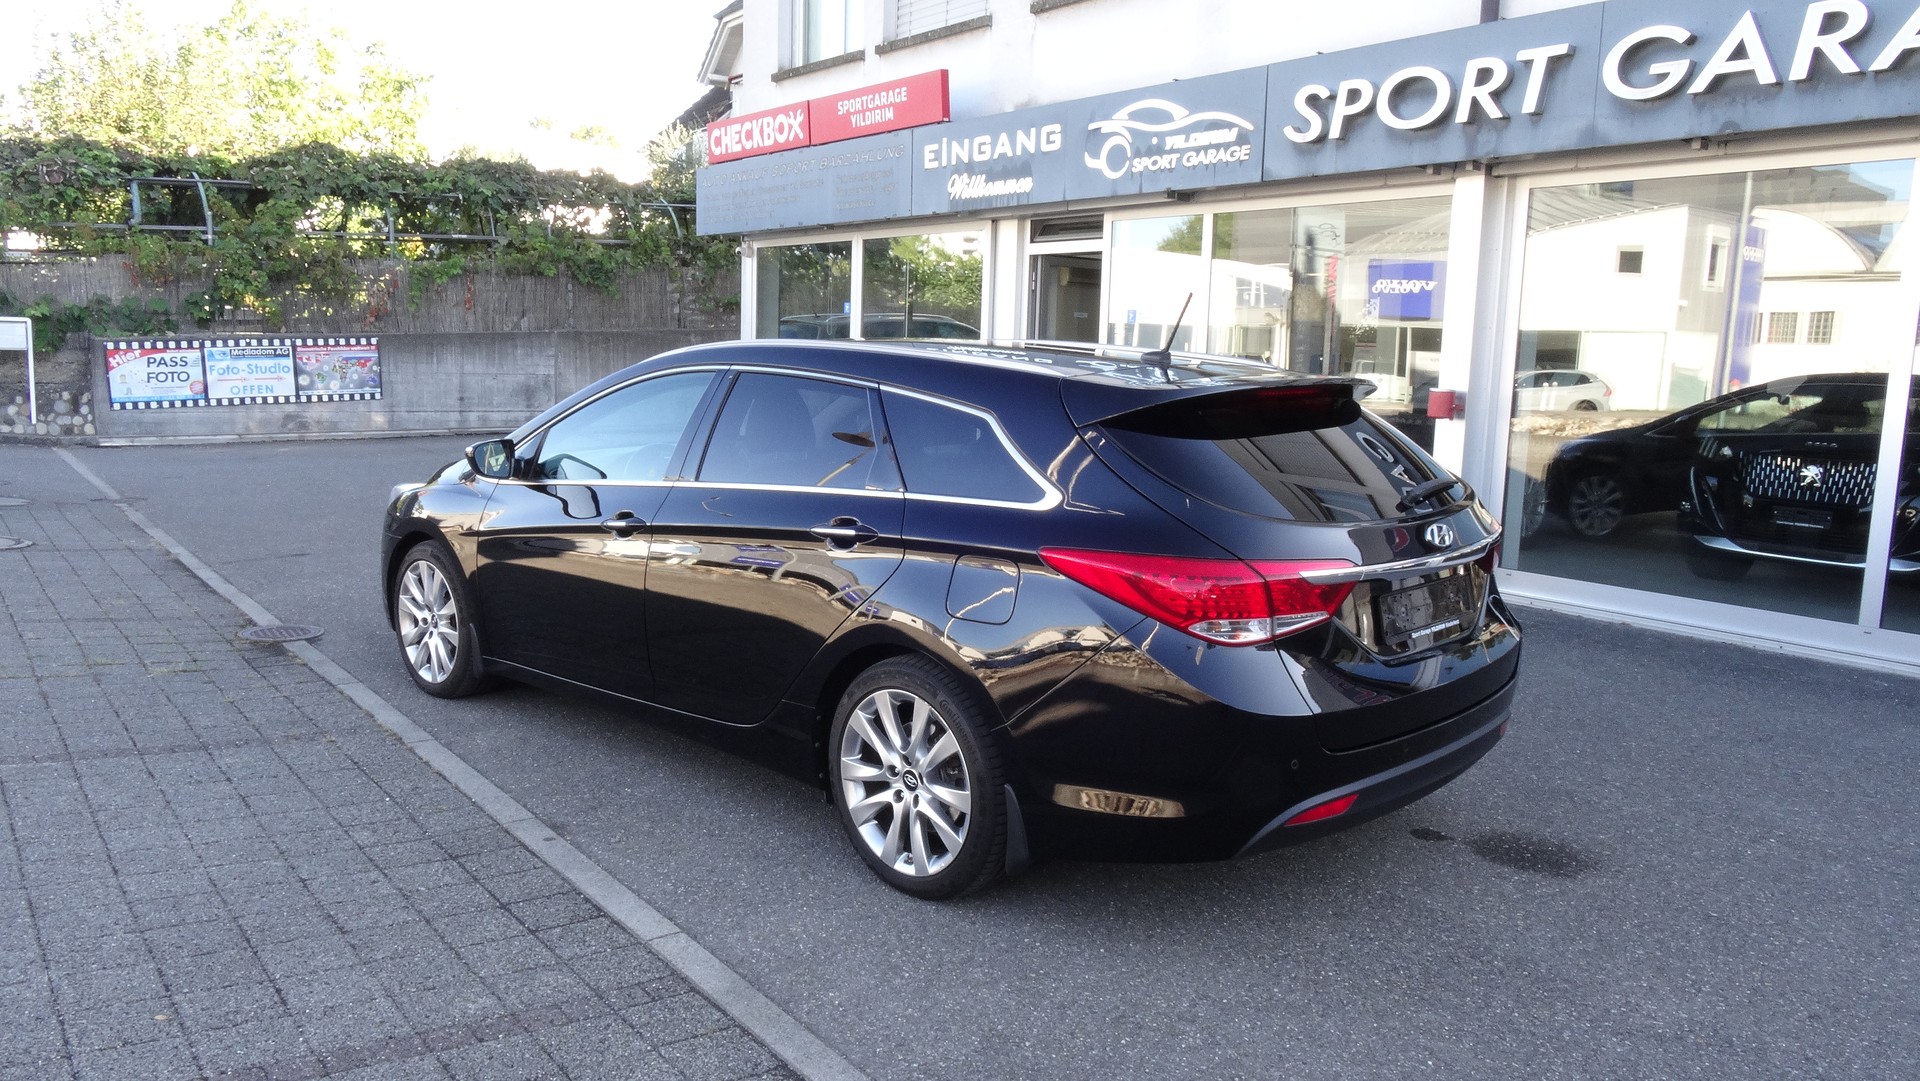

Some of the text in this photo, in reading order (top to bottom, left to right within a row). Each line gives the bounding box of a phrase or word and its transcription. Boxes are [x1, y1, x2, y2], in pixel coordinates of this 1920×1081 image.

[837, 86, 907, 116] SPORTGARAGE
[1283, 44, 1571, 143] SPORT
[850, 106, 894, 128] YILDIRIM
[710, 108, 804, 156] CHECKBOX
[924, 123, 1062, 169] EINGANG
[1131, 145, 1251, 173] SPORT GARAGE
[947, 173, 1034, 200] Willkommen
[108, 349, 141, 368] Hier
[146, 356, 189, 368] PASS
[231, 347, 289, 356] Mediadom AG
[146, 371, 190, 383] FOTO
[209, 362, 291, 376] Foto-Studio
[230, 384, 274, 395] OFFEN
